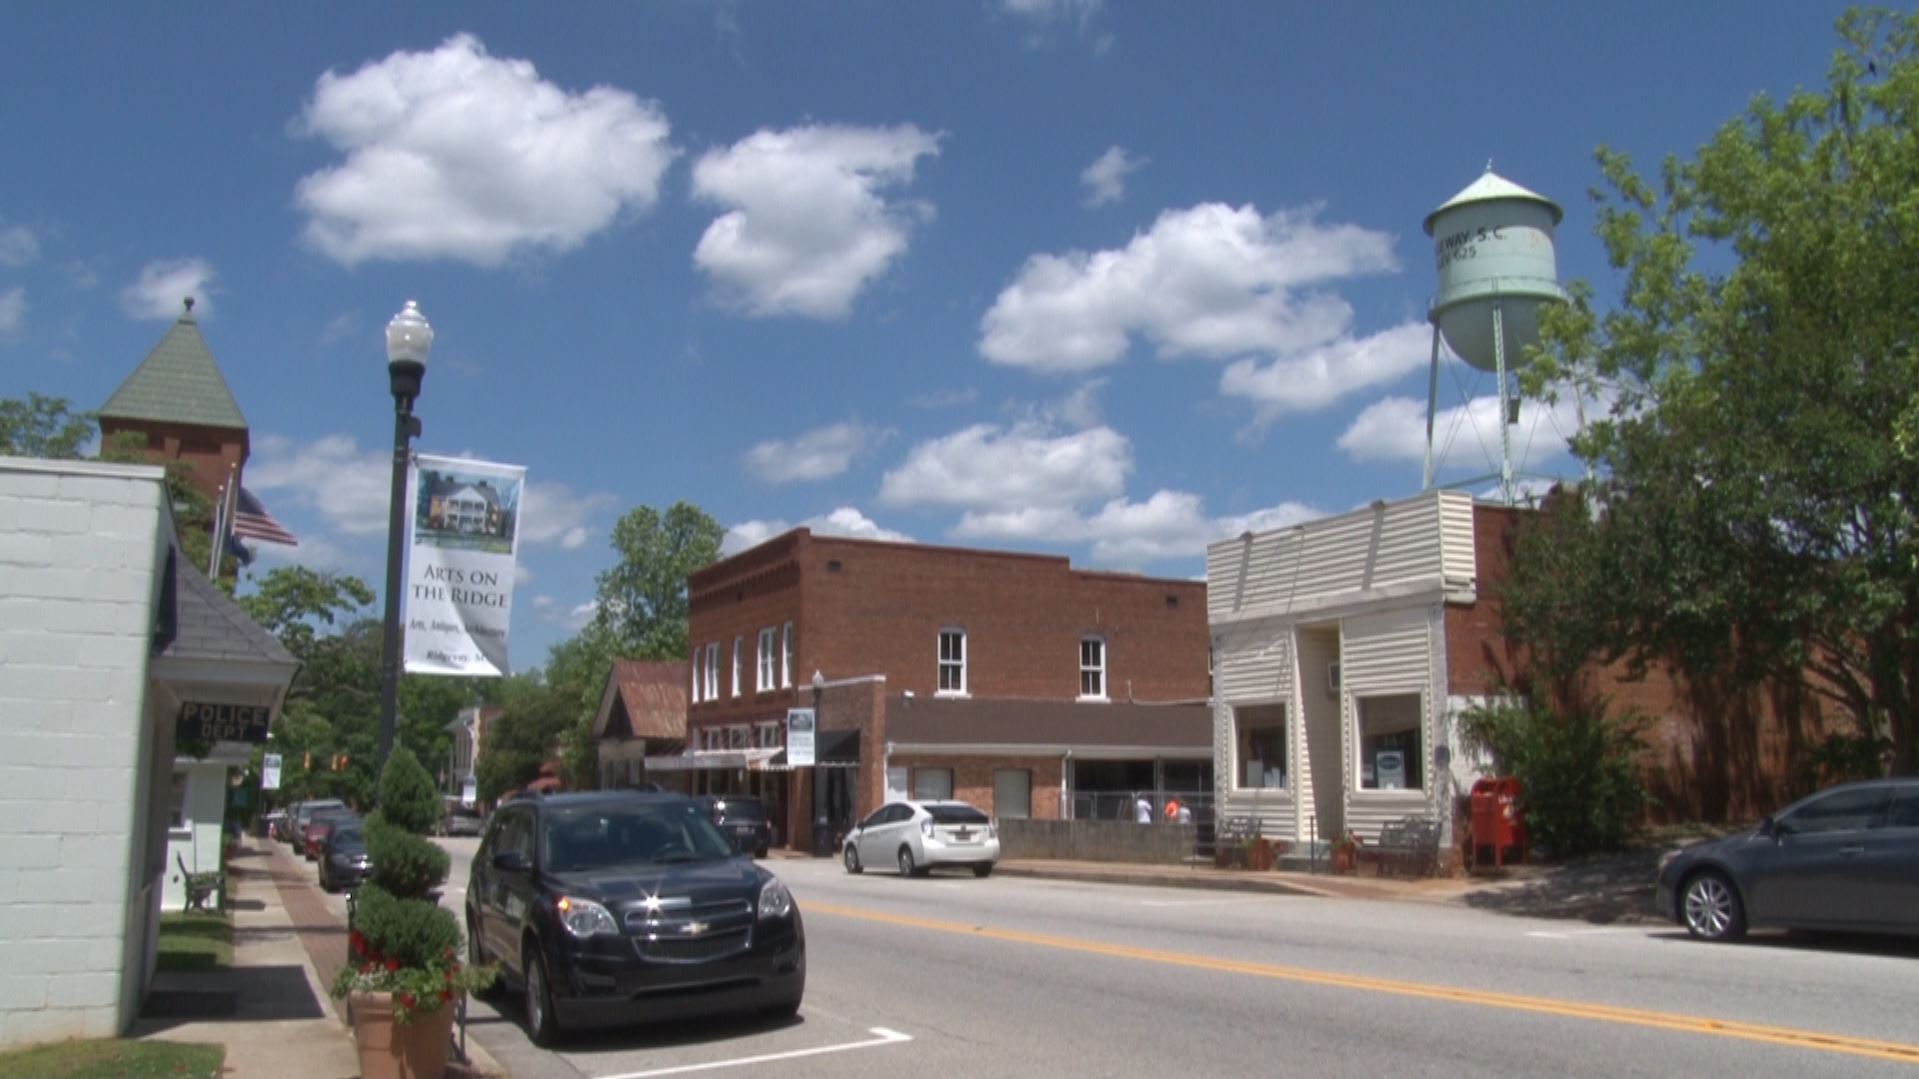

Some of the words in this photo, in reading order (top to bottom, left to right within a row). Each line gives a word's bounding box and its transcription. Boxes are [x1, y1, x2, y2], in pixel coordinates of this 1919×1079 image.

[424, 564, 464, 583] ARTS
[469, 570, 498, 587] ON
[412, 584, 446, 600] THE
[450, 587, 508, 608] RIDGE
[183, 703, 267, 727] POLICE
